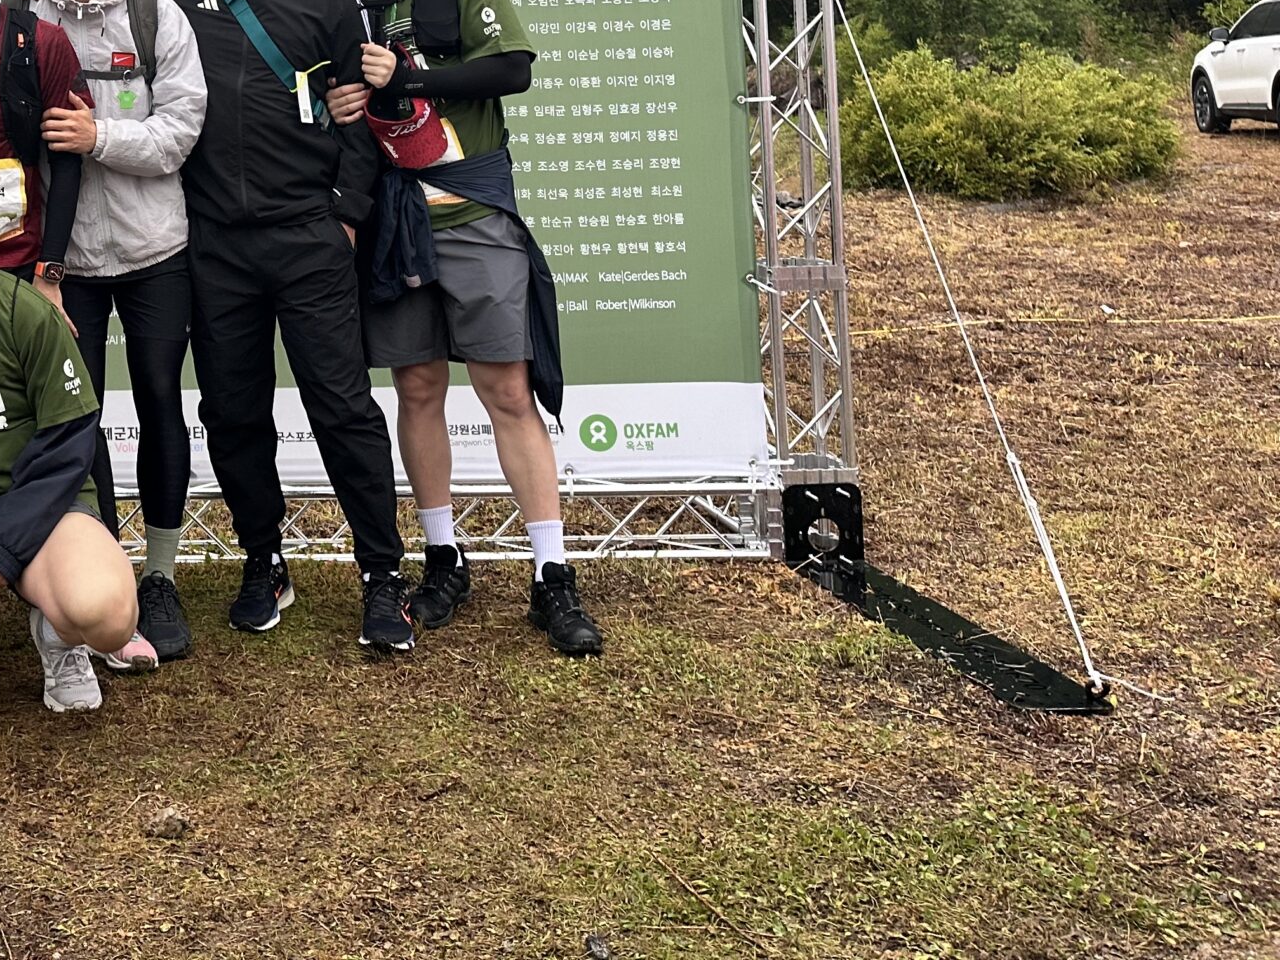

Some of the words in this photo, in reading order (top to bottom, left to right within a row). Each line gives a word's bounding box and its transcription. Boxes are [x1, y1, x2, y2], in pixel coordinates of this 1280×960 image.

[661, 269, 687, 281] Bach
[595, 300, 628, 311] Robert
[623, 422, 679, 440] OXFAM
[625, 441, 655, 452] 옥스팜
